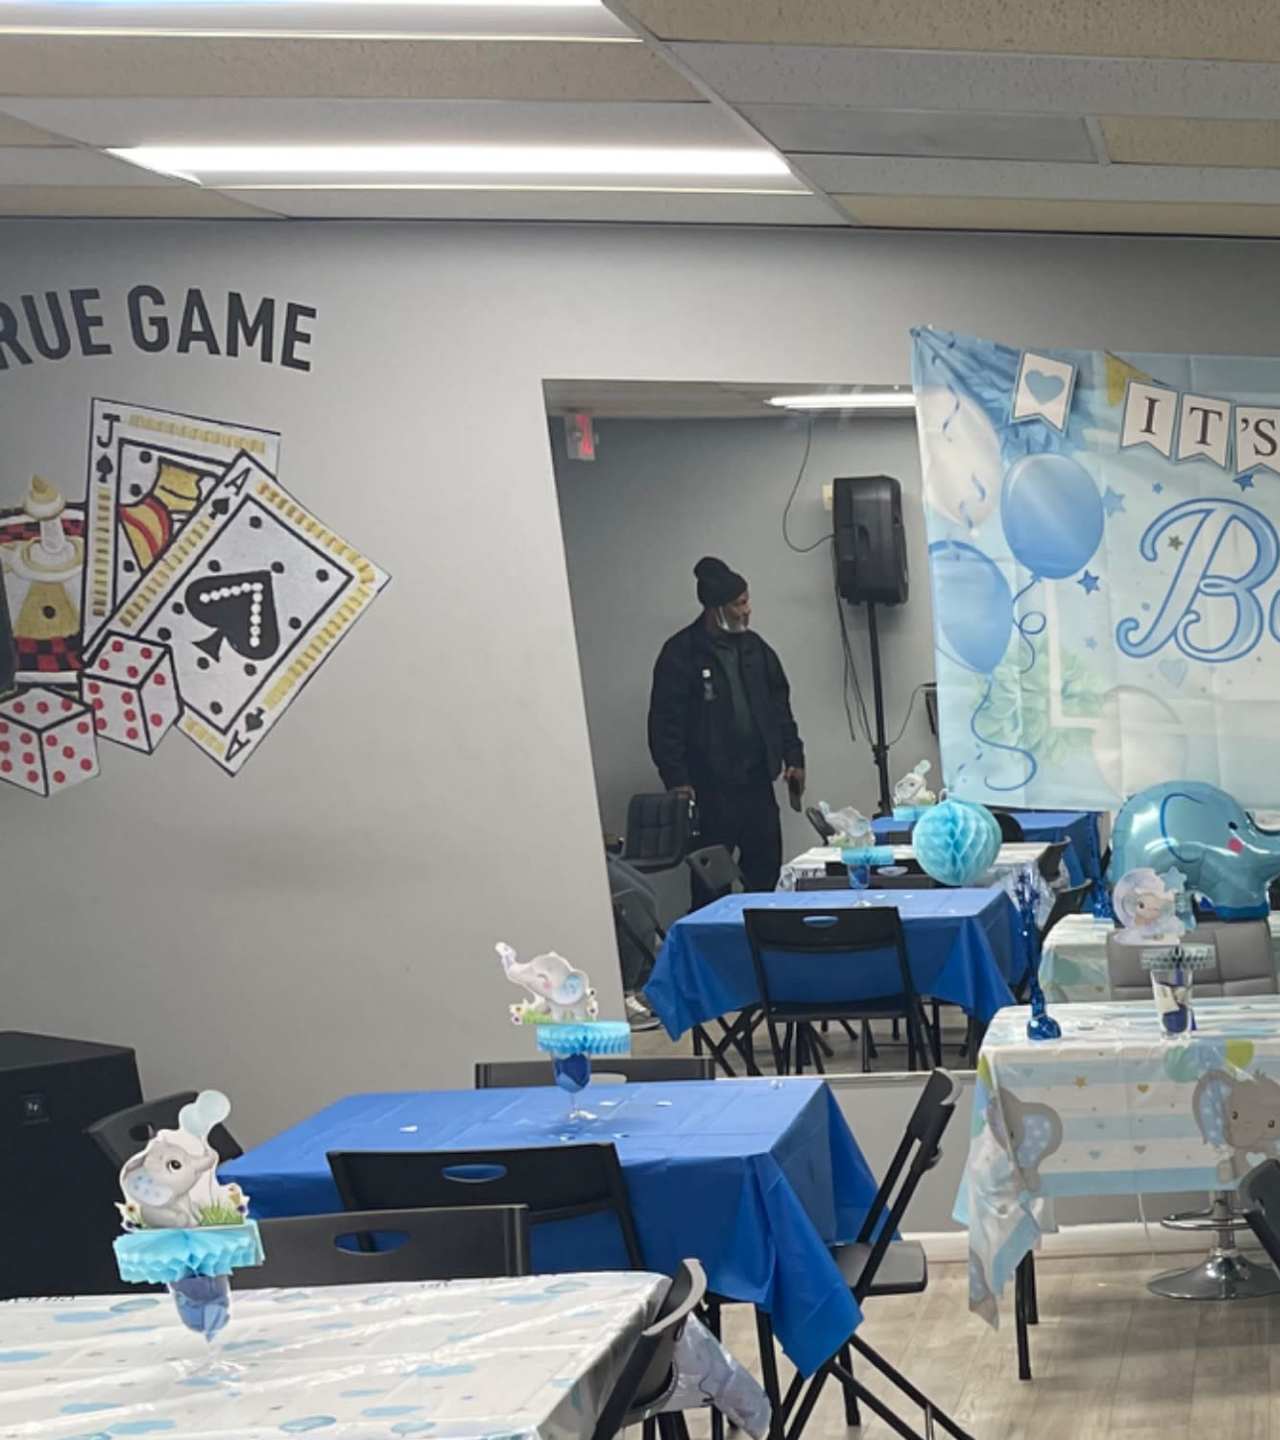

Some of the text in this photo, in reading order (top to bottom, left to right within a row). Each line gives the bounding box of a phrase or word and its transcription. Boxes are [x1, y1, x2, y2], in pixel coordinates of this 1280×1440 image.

[127, 285, 317, 371] GAME
[96, 413, 121, 448] J
[1143, 396, 1278, 458] IT'S
[225, 467, 252, 496] A
[224, 729, 252, 762] A
